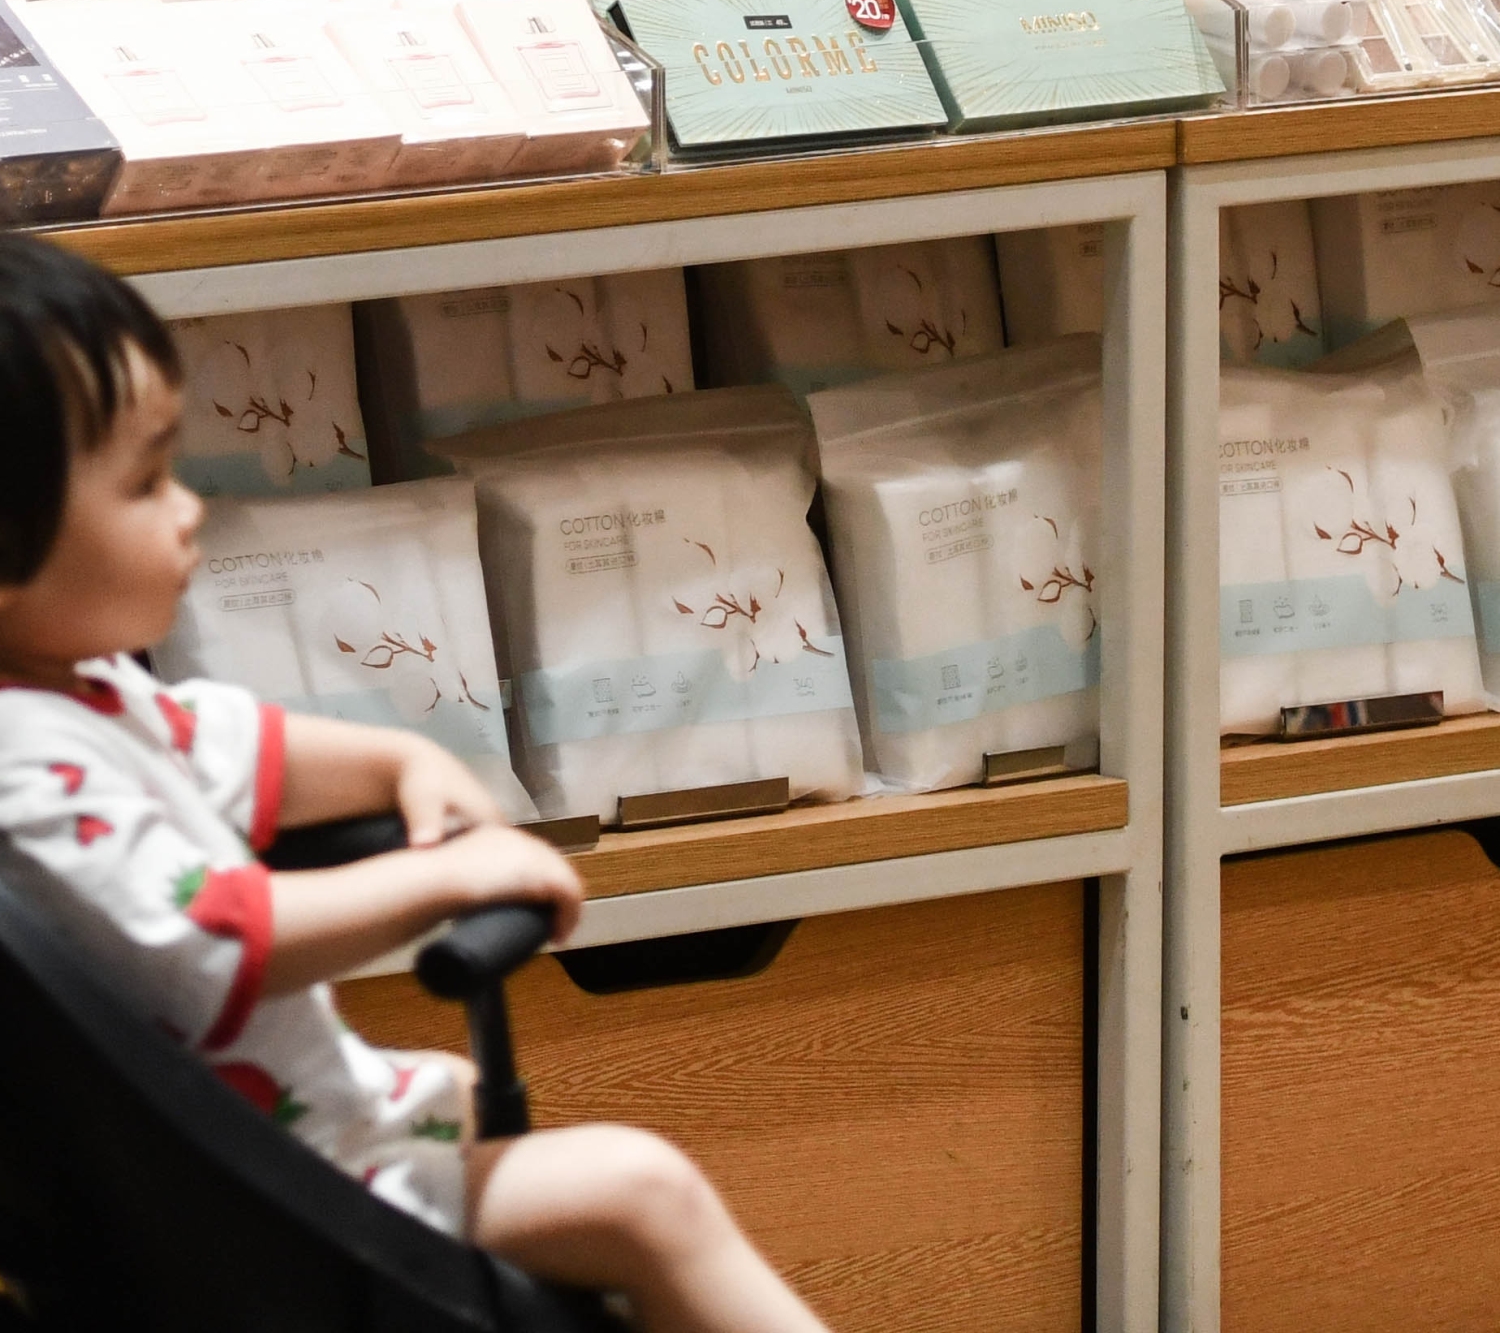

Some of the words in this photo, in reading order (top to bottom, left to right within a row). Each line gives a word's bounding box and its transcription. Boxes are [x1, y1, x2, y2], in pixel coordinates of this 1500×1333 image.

[1018, 11, 1101, 34] MINISO
[918, 497, 982, 528] COTTON
[560, 514, 626, 536] COTTON
[207, 551, 282, 575] COTTON
